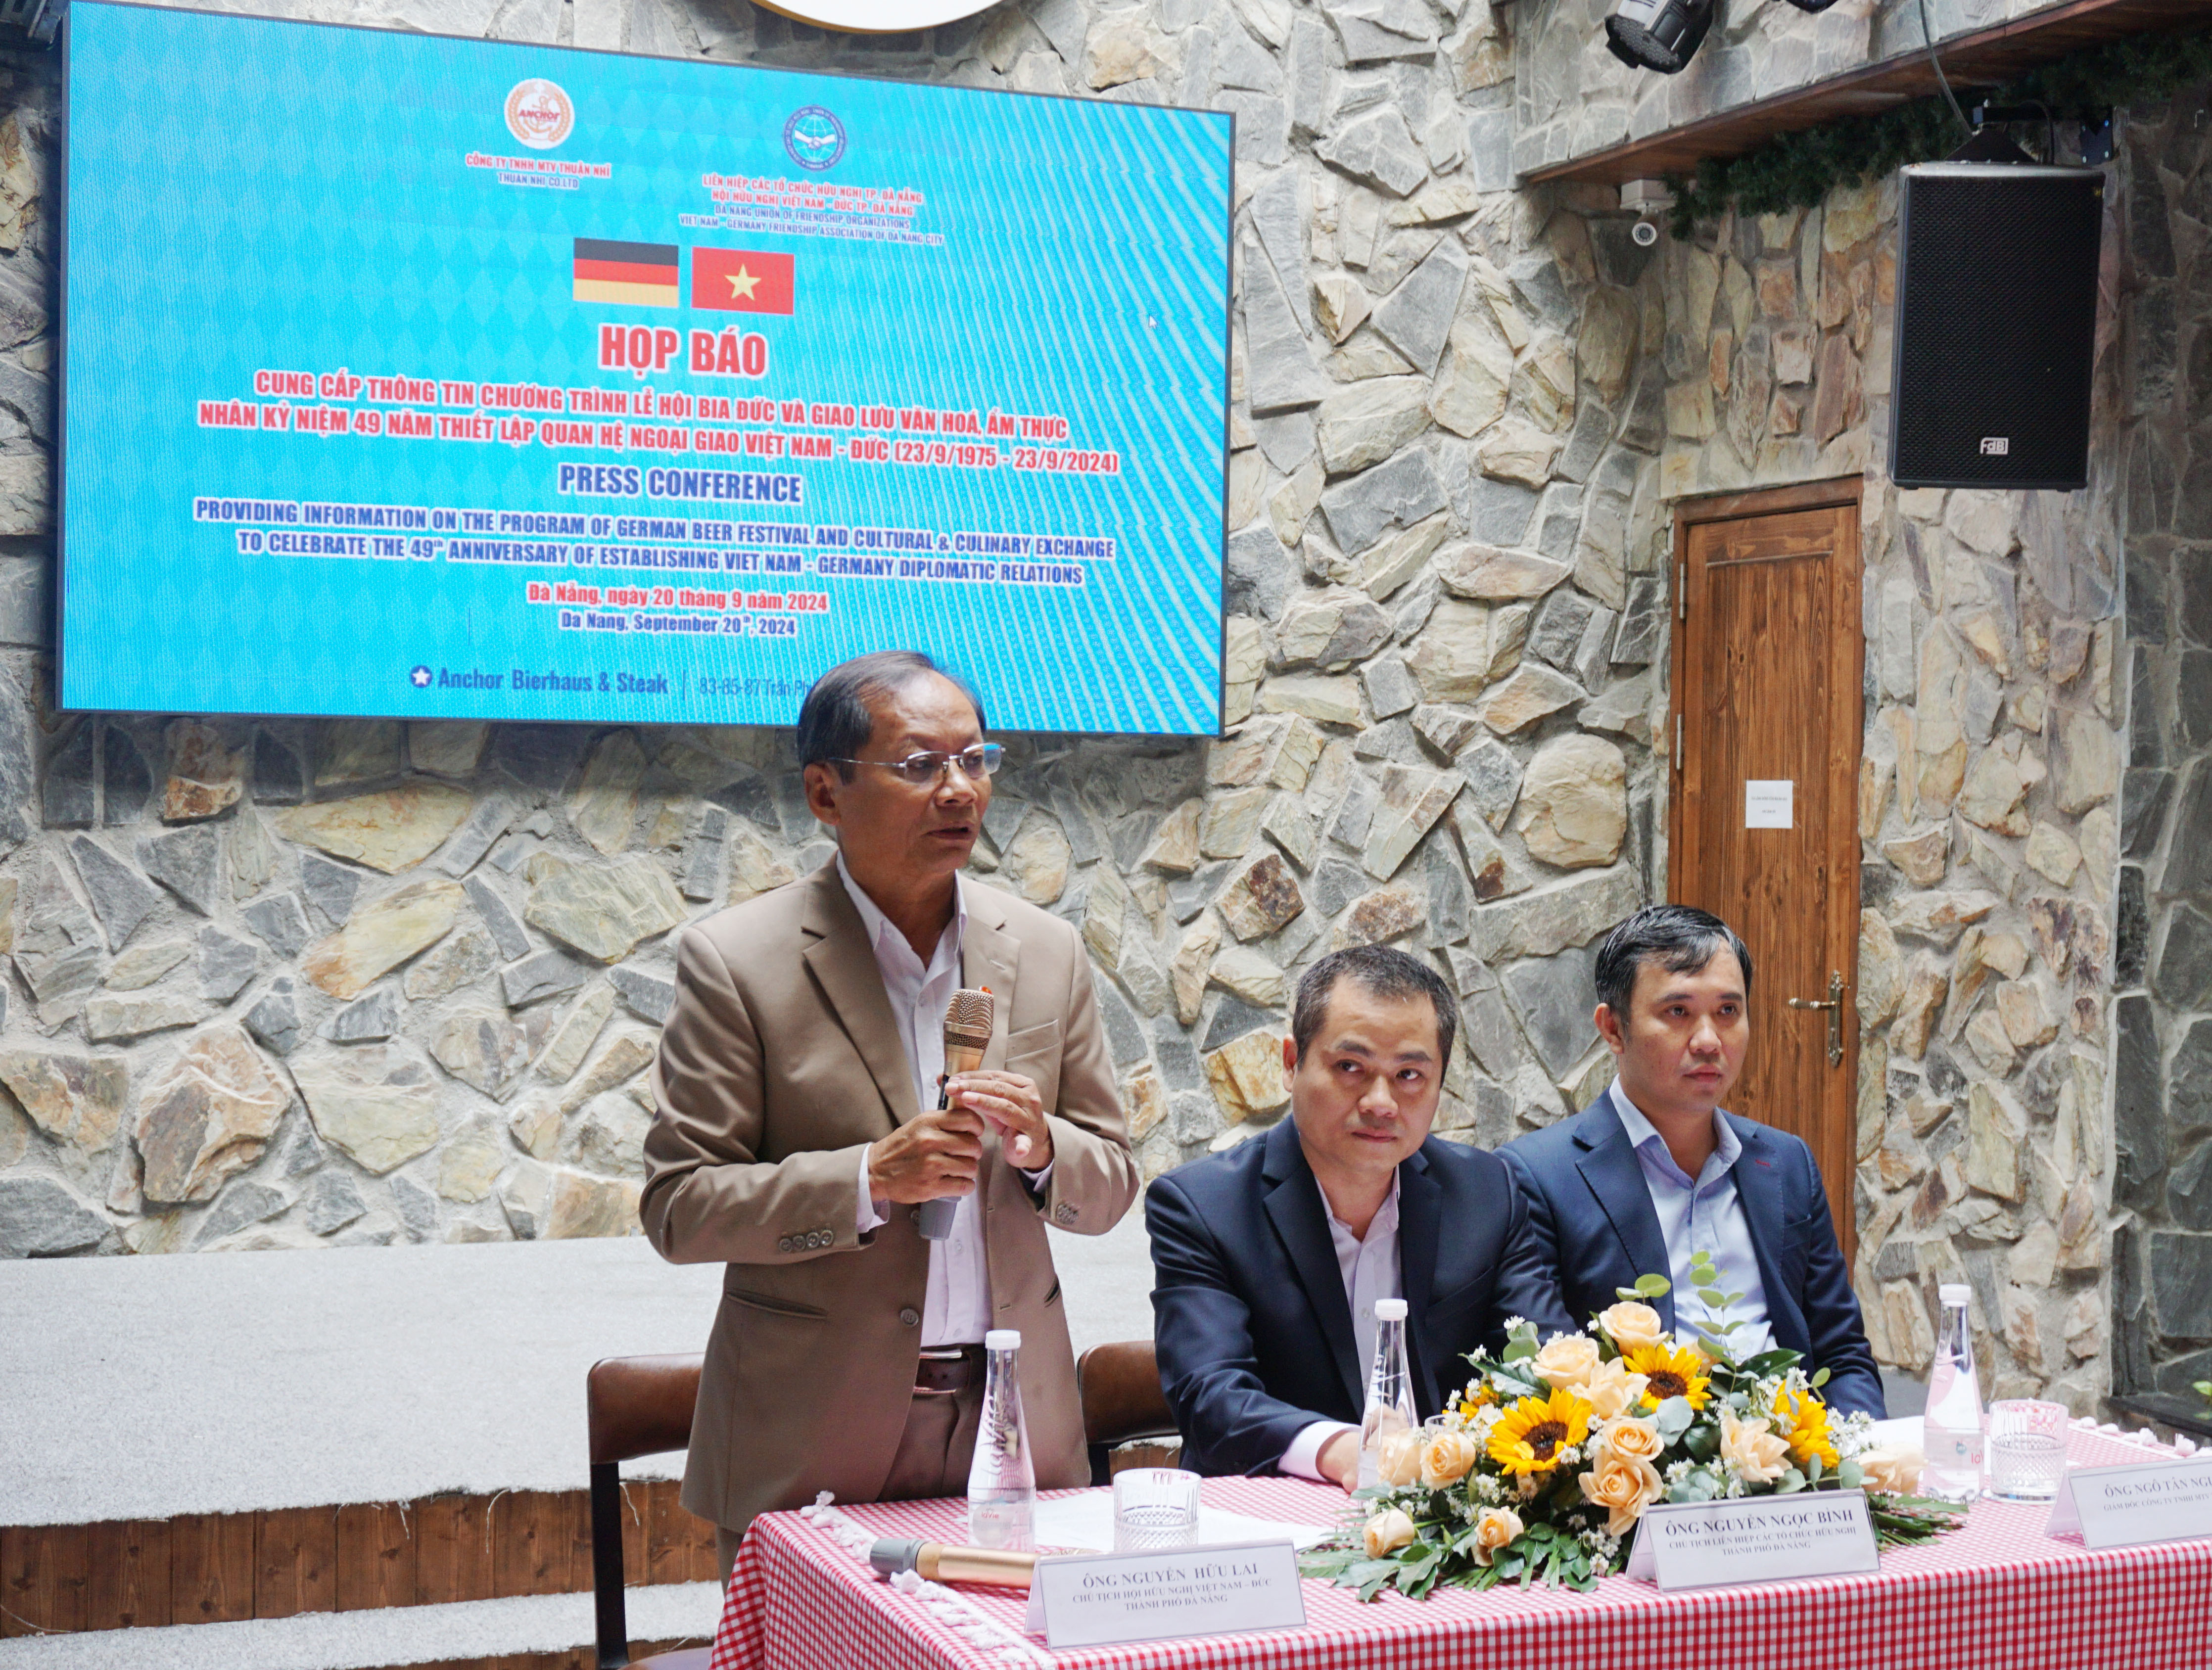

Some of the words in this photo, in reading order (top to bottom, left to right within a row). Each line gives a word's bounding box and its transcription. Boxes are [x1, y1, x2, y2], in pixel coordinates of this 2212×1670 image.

[496, 157, 506, 168] TY
[509, 158, 534, 170] TNHH
[537, 161, 556, 172] MTV
[559, 161, 590, 177] THUẬN
[499, 173, 527, 184] THUAN
[530, 176, 545, 186] NHI
[703, 173, 723, 186] LIÊN
[727, 176, 749, 189] HIỆP
[752, 177, 770, 190] CÁC
[789, 180, 813, 194] CHỨC
[817, 183, 837, 195] HỮU
[840, 186, 862, 198] NGHỊ
[712, 189, 730, 203] HỘI
[733, 189, 752, 202] HỮU
[756, 194, 779, 206] NGHỊ
[782, 195, 801, 209] VIỆT
[805, 197, 824, 208] NAM
[835, 198, 853, 211] ĐỨC
[680, 215, 697, 226] VIET
[700, 217, 718, 227] NAM
[727, 220, 766, 231] GERMANY
[769, 224, 817, 234] FRIENDSHIP
[820, 228, 873, 239] ASSOCIATION
[876, 231, 885, 240] OF
[888, 232, 898, 241] DA
[902, 233, 923, 243] NANG
[926, 234, 943, 244] CITY
[716, 205, 726, 214] DA
[730, 206, 752, 217] NANG
[755, 208, 780, 219] UNION
[783, 211, 793, 219] OF
[796, 211, 843, 223] FRIENDSHIP
[847, 216, 909, 230] ORGANIZATIONS
[602, 325, 678, 376] HỌP
[692, 327, 765, 375] BÁO
[256, 371, 313, 396] CUNG
[321, 368, 361, 398] CẤP
[368, 375, 435, 402] THÔNG
[442, 382, 474, 405] TIN
[481, 384, 563, 410] CHƯƠNG
[569, 388, 627, 414] TRÌNH
[634, 388, 654, 415] LỄ
[659, 392, 691, 422] HỘI
[699, 399, 730, 419] BIA
[737, 398, 775, 421] ĐỨC
[781, 400, 805, 424] VÀ
[812, 405, 855, 426] GIAO
[861, 405, 894, 429] LƯU
[901, 407, 936, 431] VĂN
[987, 408, 1014, 435] ẨM
[1020, 415, 1067, 442] THỰC
[201, 400, 256, 426] NHÂN
[263, 403, 290, 428] KỶ
[297, 406, 347, 435] NIỆM
[354, 411, 381, 433] 49
[388, 410, 432, 437] NĂM
[439, 411, 494, 439] THIẾT
[501, 417, 535, 445] LẬP
[542, 421, 593, 445] QUAN
[601, 423, 623, 451] HỆ
[630, 427, 688, 455] NGOẠI
[696, 430, 739, 452] GIAO
[745, 432, 785, 459] VIỆT
[792, 436, 832, 457] NAM
[850, 437, 889, 461] ĐỨC
[895, 442, 996, 466] (23/9/1975
[1015, 449, 1118, 472] 23/9/2024)
[560, 465, 639, 495] PRESS
[649, 469, 801, 503] CONFERENCE
[197, 500, 297, 522] PROVIDING
[304, 505, 426, 528] INFORMATION
[432, 510, 456, 529] ON
[463, 511, 494, 531] THE
[500, 514, 585, 535] PROGRAM
[591, 517, 611, 536] OF
[617, 519, 687, 539] GERMAN
[693, 521, 732, 541] BEER
[738, 524, 810, 545] FESTIVAL
[816, 528, 848, 546] AND
[854, 529, 933, 550] CULTURAL
[938, 535, 950, 551] &
[955, 533, 1031, 555] CULINARY
[1035, 537, 1114, 558] EXCHANGE
[239, 532, 262, 551] TO
[269, 533, 366, 556] CELEBRATE
[373, 538, 405, 557] THE
[411, 539, 443, 558] 49th
[448, 541, 568, 563] ANNIVERSARY
[573, 546, 594, 564] OF
[600, 547, 718, 569] ESTABLISHING
[724, 552, 759, 570] VIET
[765, 554, 801, 573] NAM
[818, 556, 894, 576] GERMANY
[899, 559, 995, 580] DIPLOMATIC
[1000, 563, 1083, 584] RELATIONS
[529, 583, 551, 601] Đà
[608, 586, 649, 606] ngày
[654, 588, 674, 605] 20
[679, 589, 726, 609] tháng
[732, 591, 742, 608] 9
[747, 592, 783, 609] năm
[788, 593, 827, 611] 2024
[562, 612, 581, 628] Da
[587, 612, 629, 631] Nang,
[634, 614, 717, 632] September
[758, 618, 796, 635] 2024
[438, 668, 503, 689] Anchor
[513, 669, 592, 692] Bierhaus
[598, 671, 610, 692] &
[617, 672, 668, 694] Steak
[700, 677, 760, 696] 83-85-87
[2105, 1484, 2132, 1497] ÔNG
[2135, 1479, 2162, 1495] NGÔ
[1666, 1520, 1699, 1536] ÔNG
[1703, 1514, 1766, 1533] NGUYỄN
[1771, 1511, 1814, 1529] NGỌC
[1083, 1573, 1117, 1588] ÔNG
[1122, 1567, 1186, 1585] NGUYỄN
[1194, 1564, 1227, 1578] HỮU
[1097, 1592, 1121, 1603] TỊCH
[1196, 1582, 1218, 1593] VIỆT
[1221, 1580, 1242, 1591] NAM
